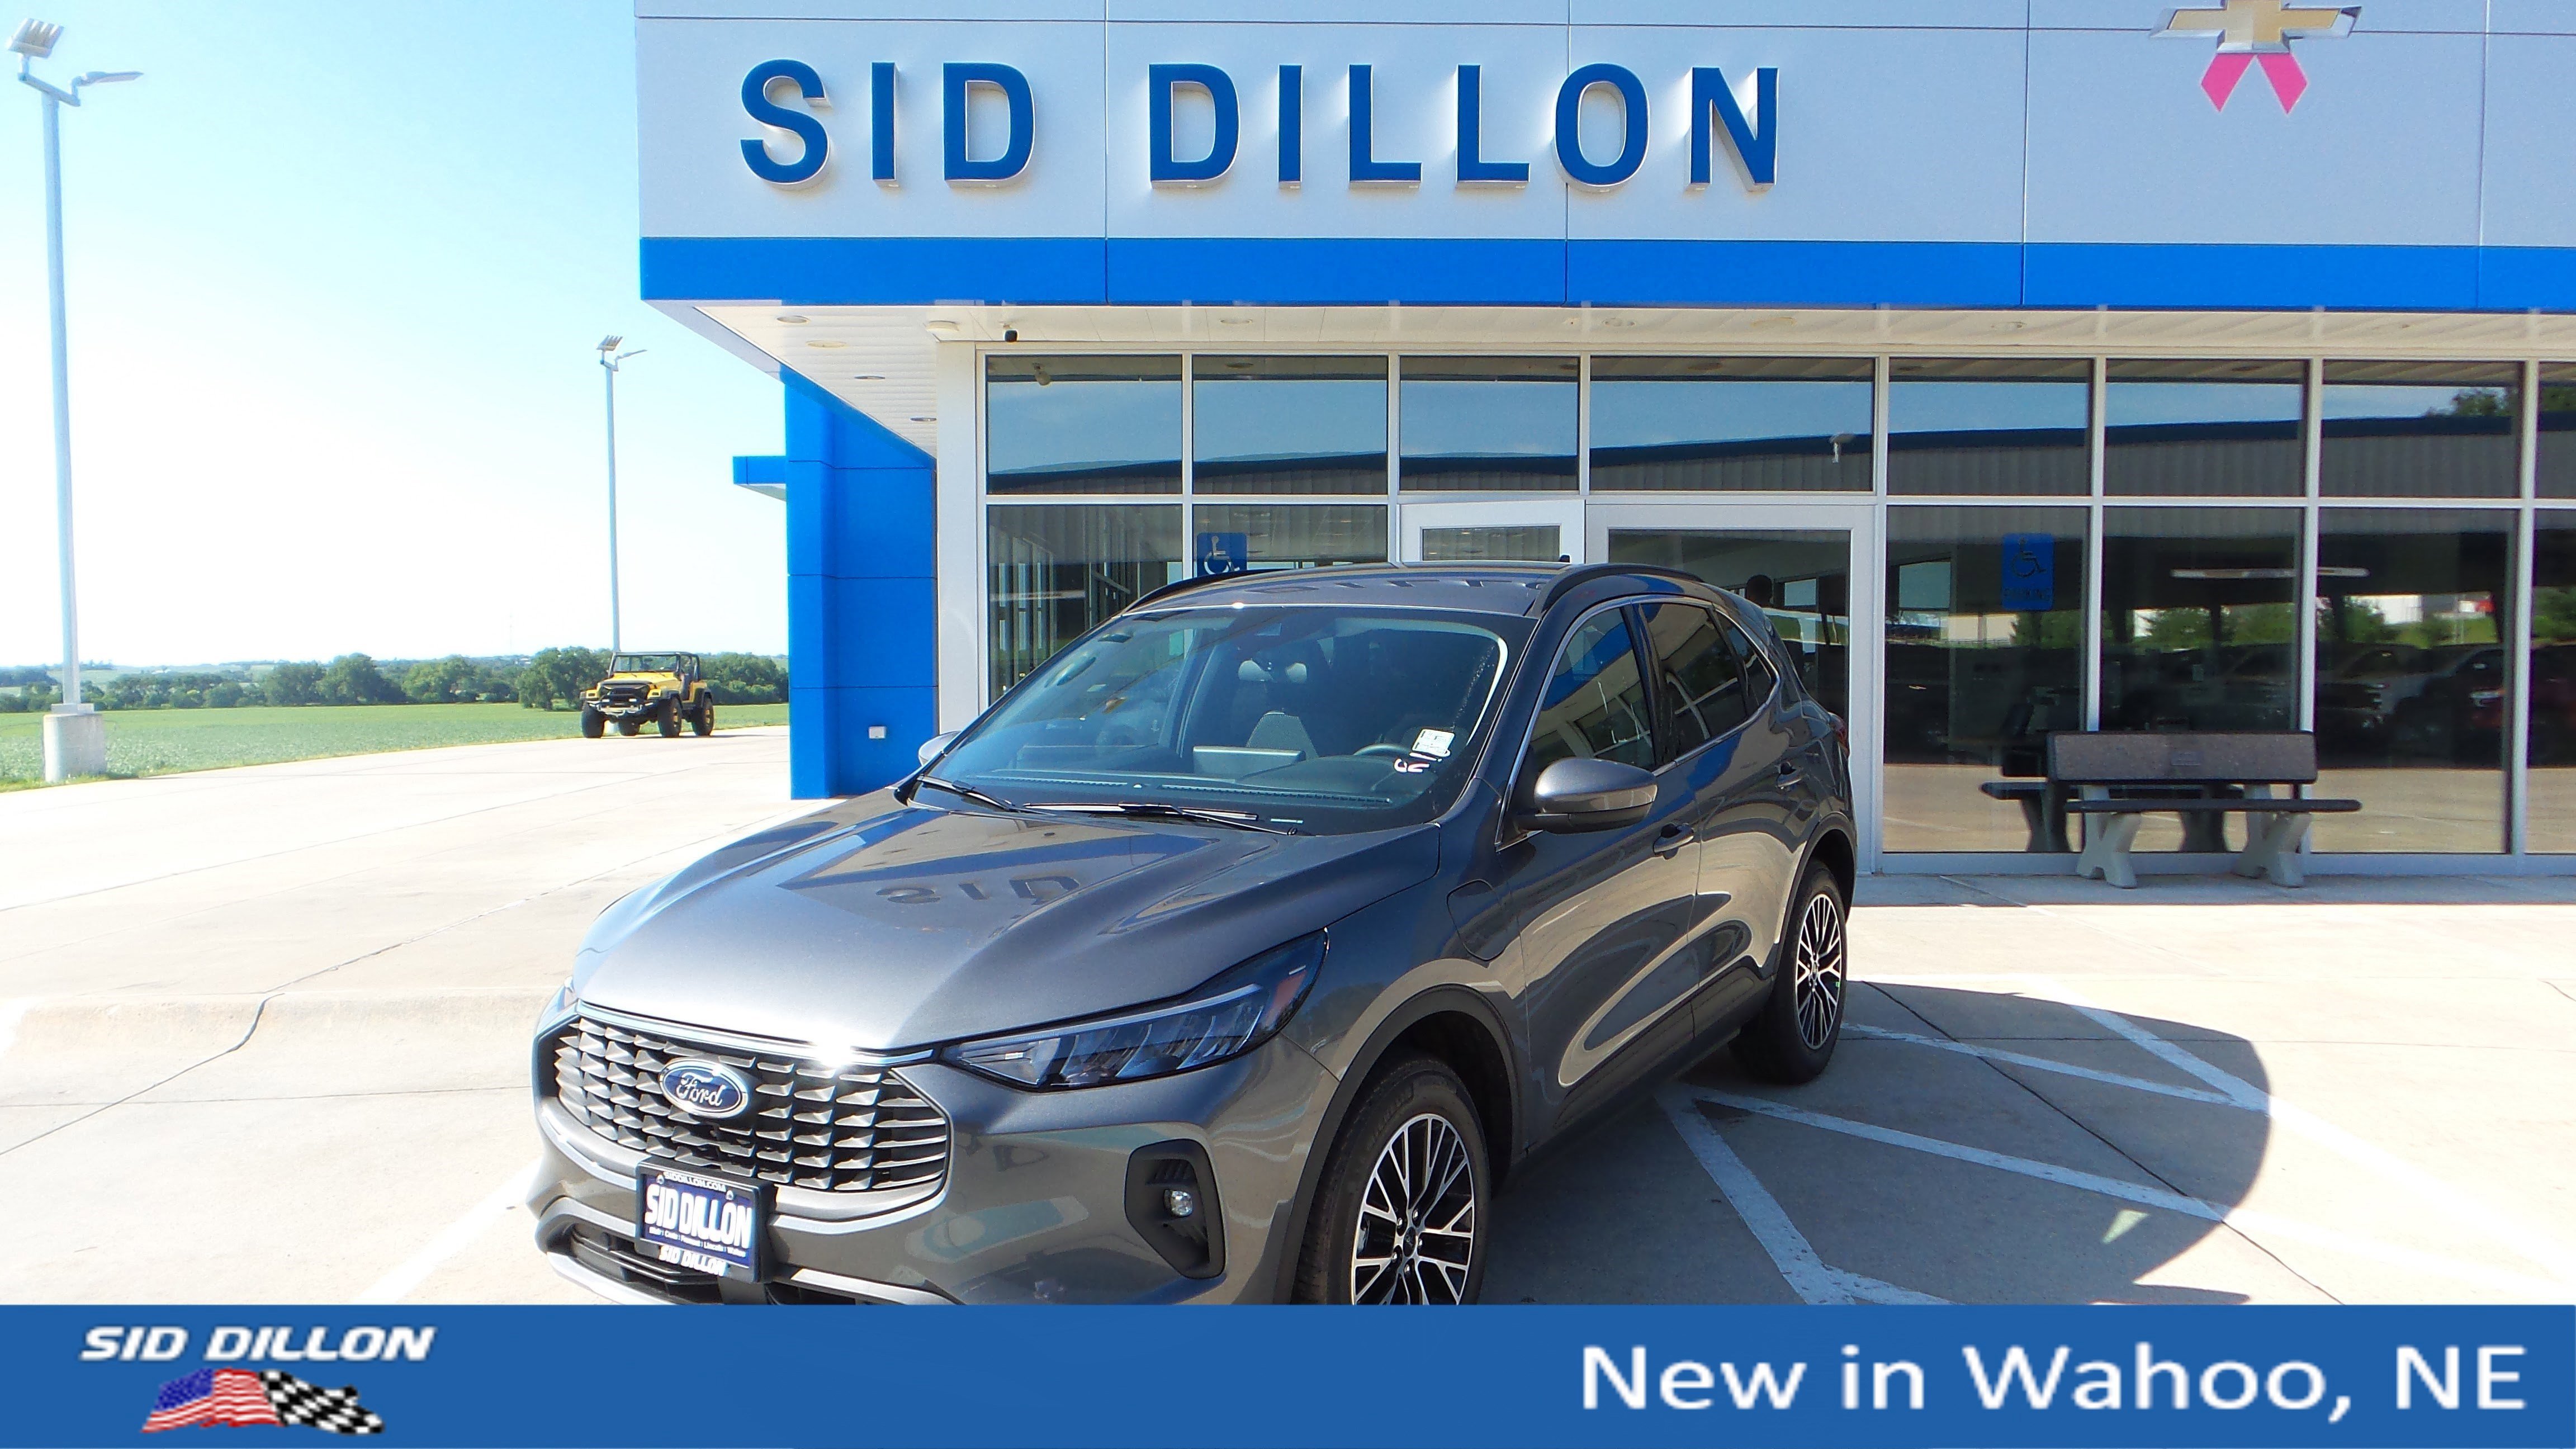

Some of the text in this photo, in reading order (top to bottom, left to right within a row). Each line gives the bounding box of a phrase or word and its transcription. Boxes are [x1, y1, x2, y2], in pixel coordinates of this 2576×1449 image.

[740, 59, 1778, 185] SID DILLON
[675, 1072, 726, 1107] Ford
[645, 1183, 752, 1249] SID DILLON
[659, 1246, 726, 1276] SID DILLON
